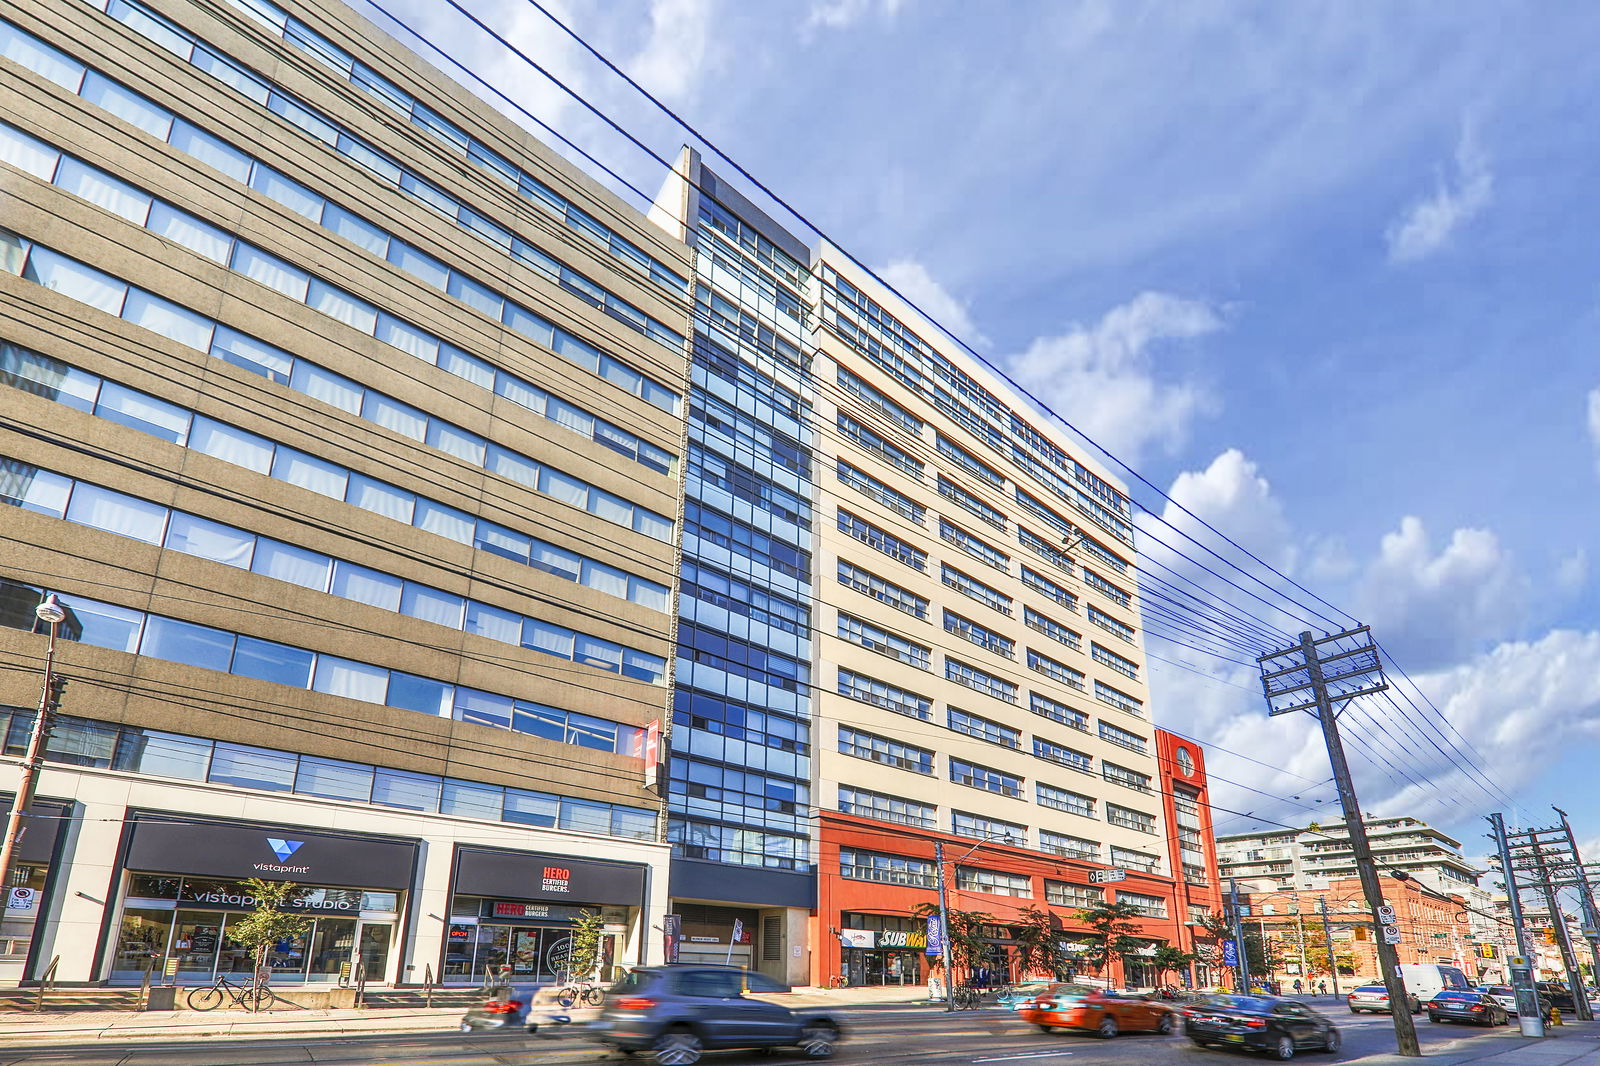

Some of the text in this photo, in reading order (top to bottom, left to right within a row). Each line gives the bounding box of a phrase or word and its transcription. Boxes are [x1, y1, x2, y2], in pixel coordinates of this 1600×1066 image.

[253, 863, 309, 874] vistaprint
[543, 866, 570, 880] HERO
[542, 878, 568, 886] CERTIFIED
[194, 891, 350, 910] vistaprt STUDIO
[496, 903, 524, 915] HERO
[525, 904, 549, 912] CERTIFIED
